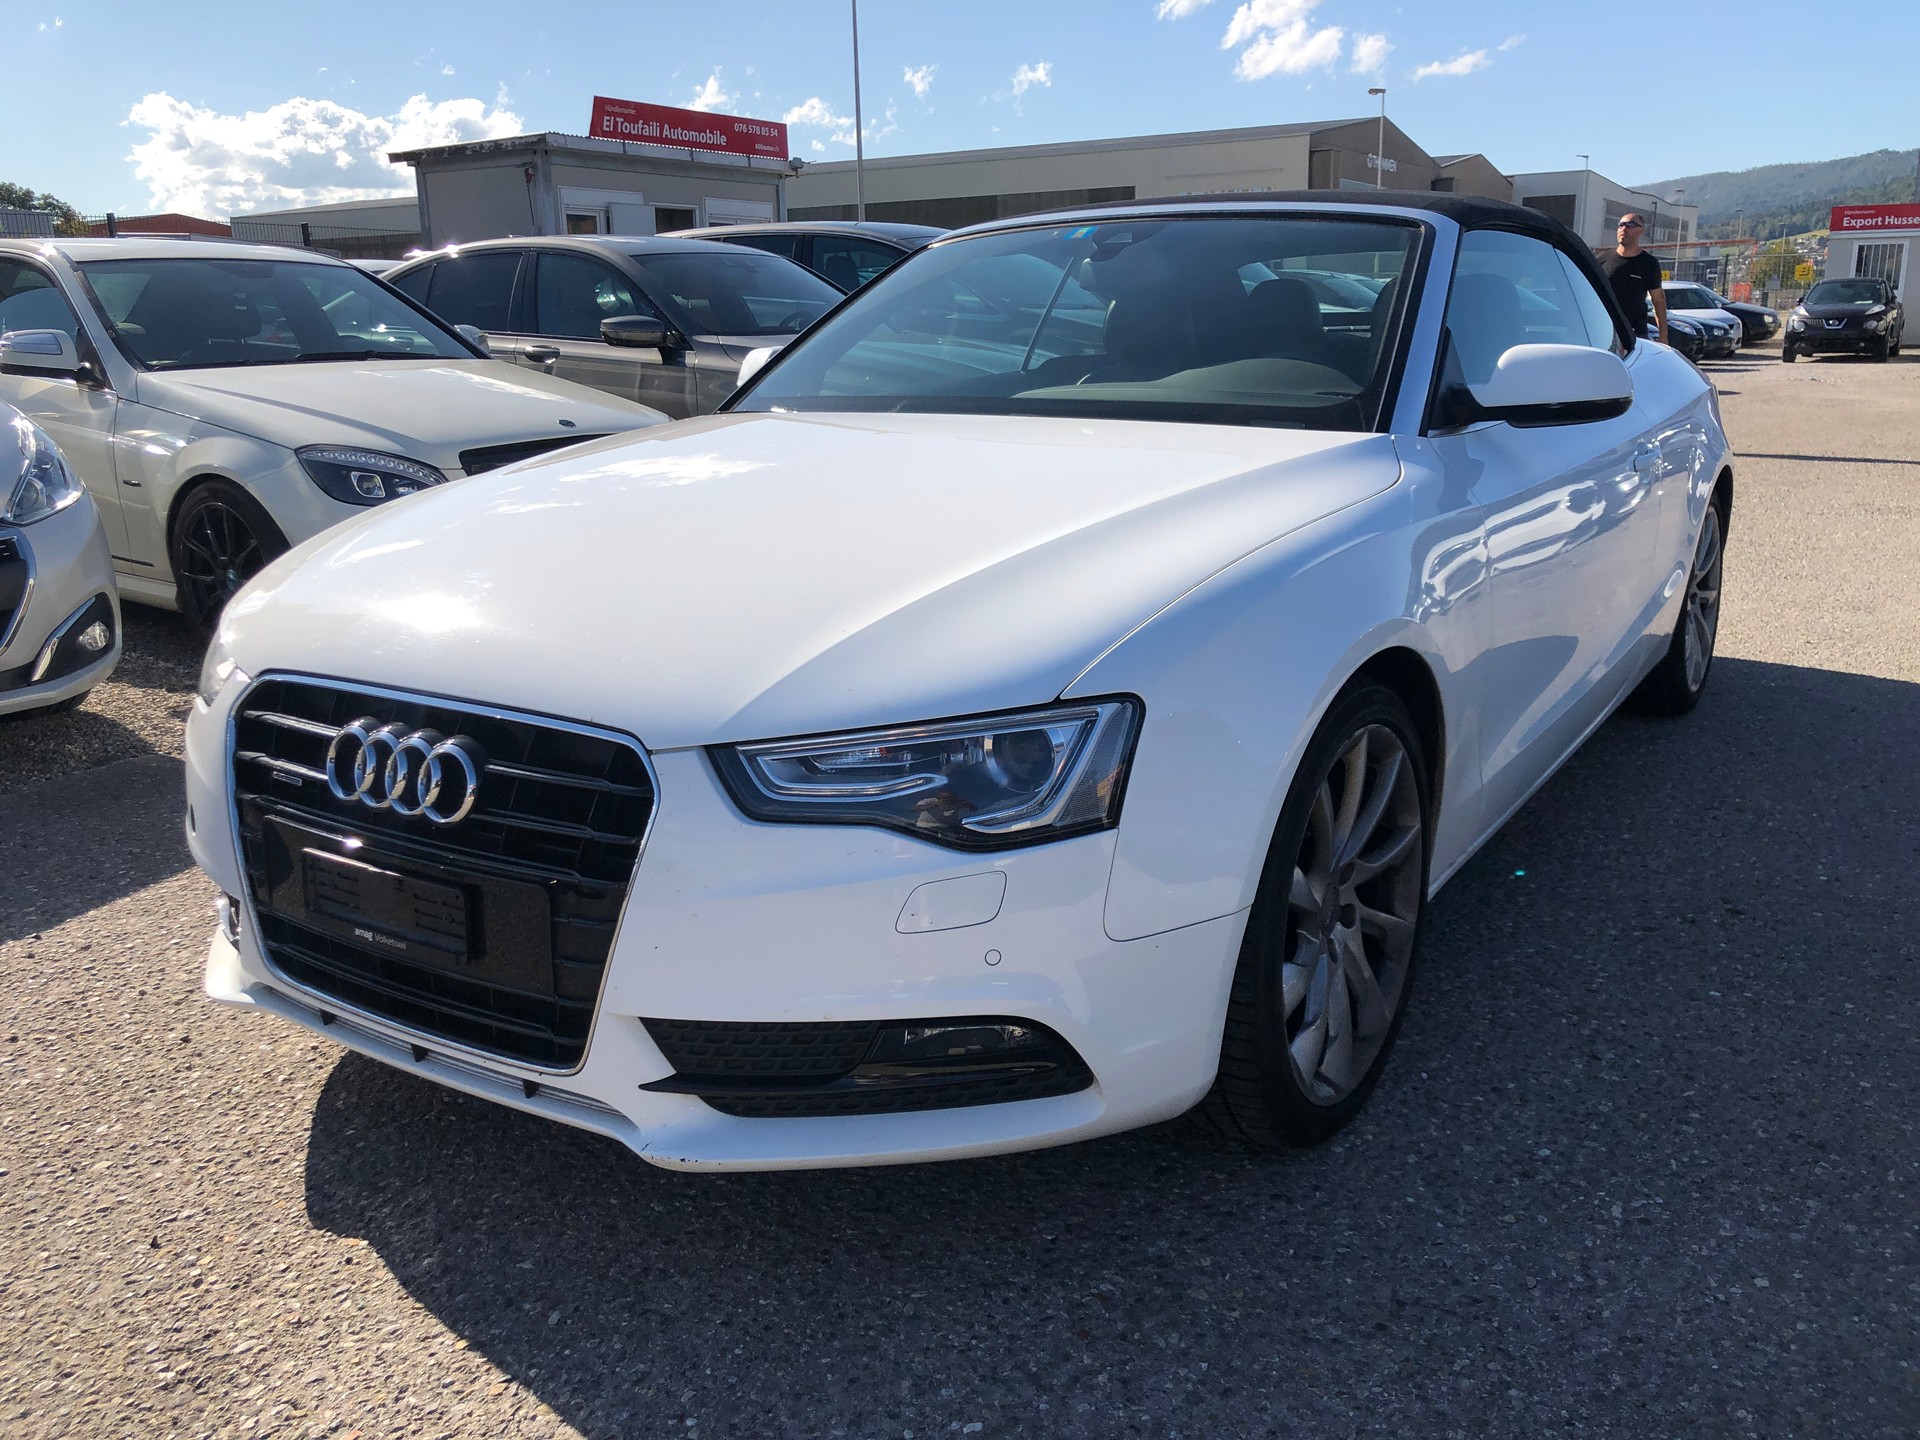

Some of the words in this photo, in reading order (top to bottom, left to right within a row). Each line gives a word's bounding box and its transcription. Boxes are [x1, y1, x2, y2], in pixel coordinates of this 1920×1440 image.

[602, 115, 614, 132] El
[616, 117, 660, 137] Toufaili
[662, 124, 727, 145] Automobile
[734, 122, 749, 133] 076
[749, 125, 760, 135] 578
[761, 127, 769, 137] 85
[770, 128, 778, 138] 54
[1843, 216, 1882, 229] Export
[1885, 215, 1920, 225] Husse
[354, 928, 373, 941] amag
